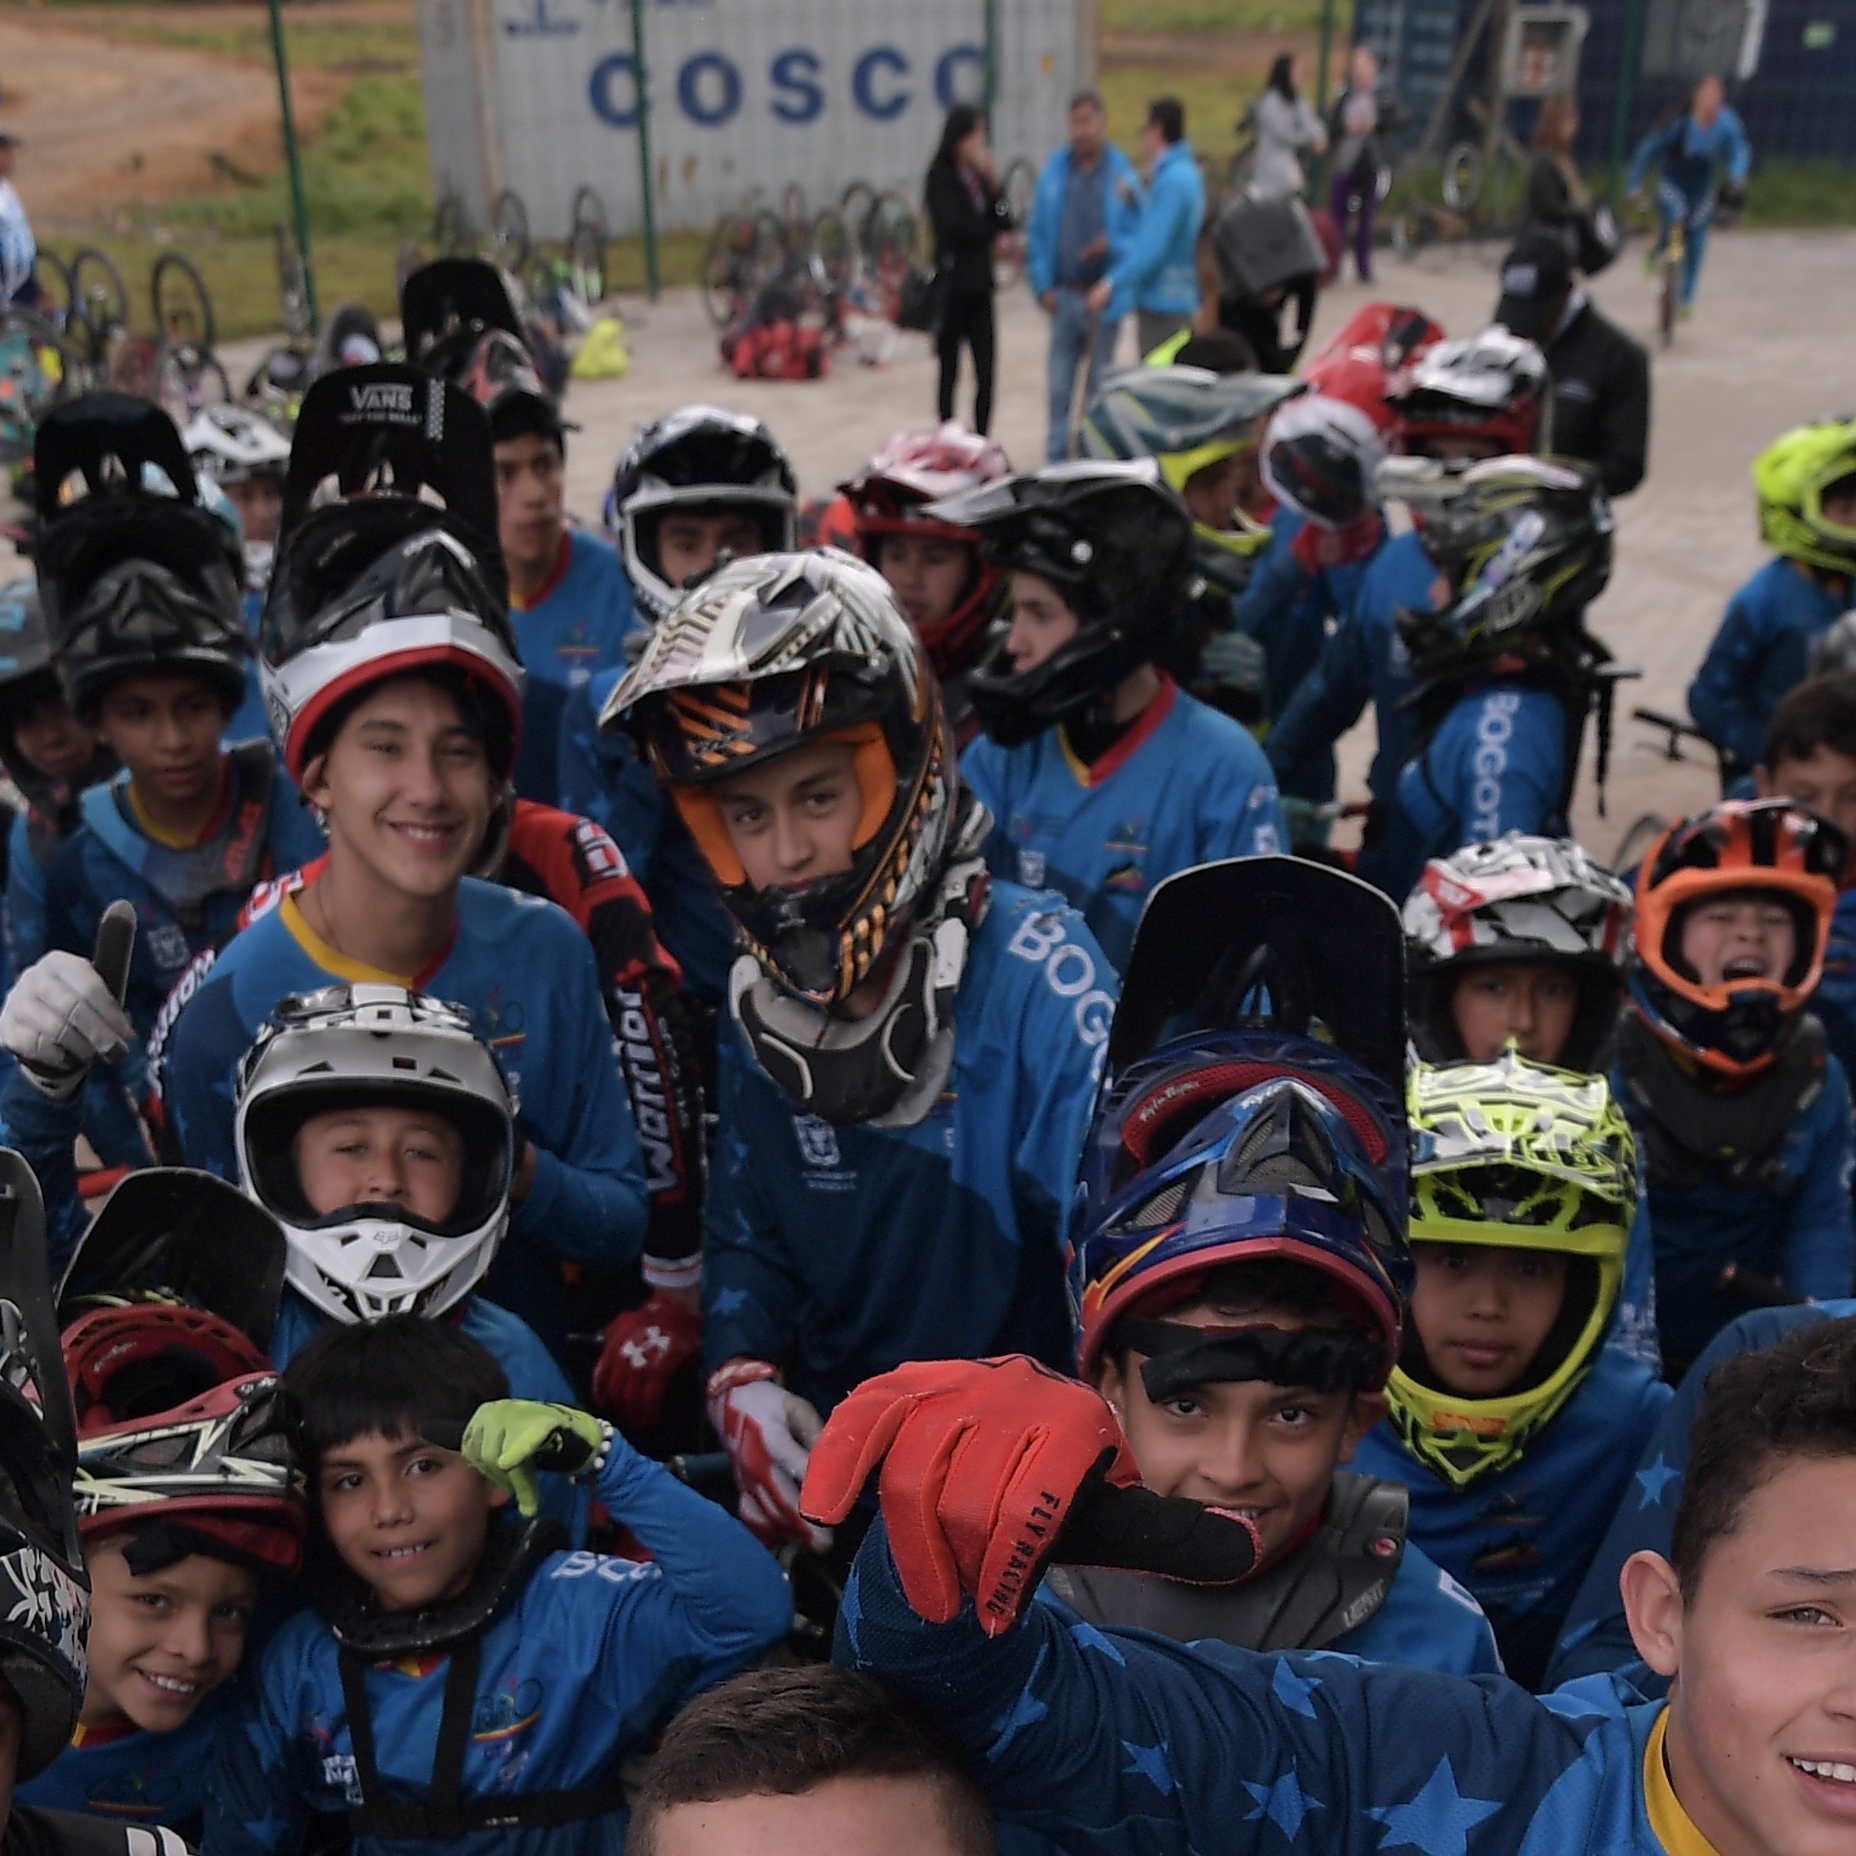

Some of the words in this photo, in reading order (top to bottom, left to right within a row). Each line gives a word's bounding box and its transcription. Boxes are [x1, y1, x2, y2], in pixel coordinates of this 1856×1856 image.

[589, 44, 989, 128] COSCO
[350, 386, 414, 412] VANS
[1471, 690, 1521, 836] BOGOT
[1024, 1490, 1061, 1542] FLY
[988, 1541, 1041, 1617] RACING
